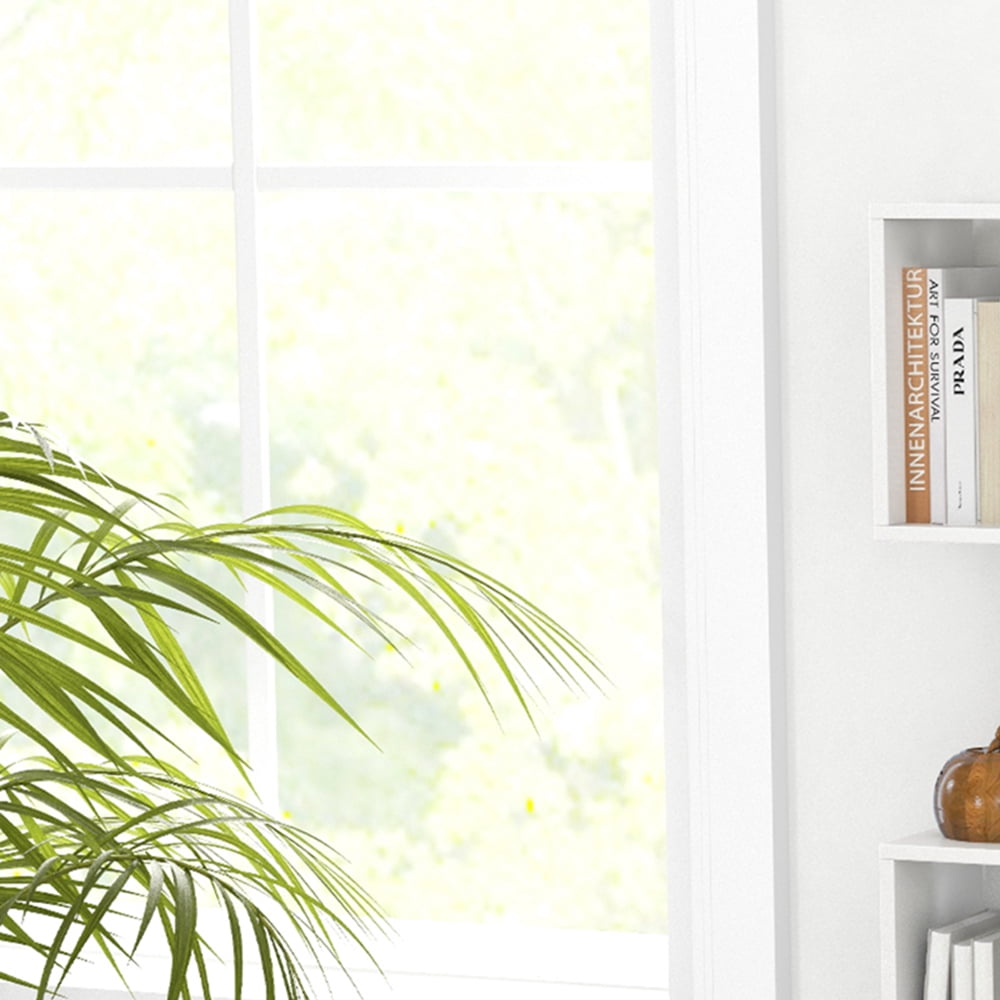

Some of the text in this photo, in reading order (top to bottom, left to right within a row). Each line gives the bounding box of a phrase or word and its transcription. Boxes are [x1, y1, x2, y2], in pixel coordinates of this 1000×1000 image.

[906, 268, 926, 491] INNENARCHITEKTUR
[928, 279, 941, 422] ART FOR SURVIVAL
[953, 327, 965, 395] PRADA
